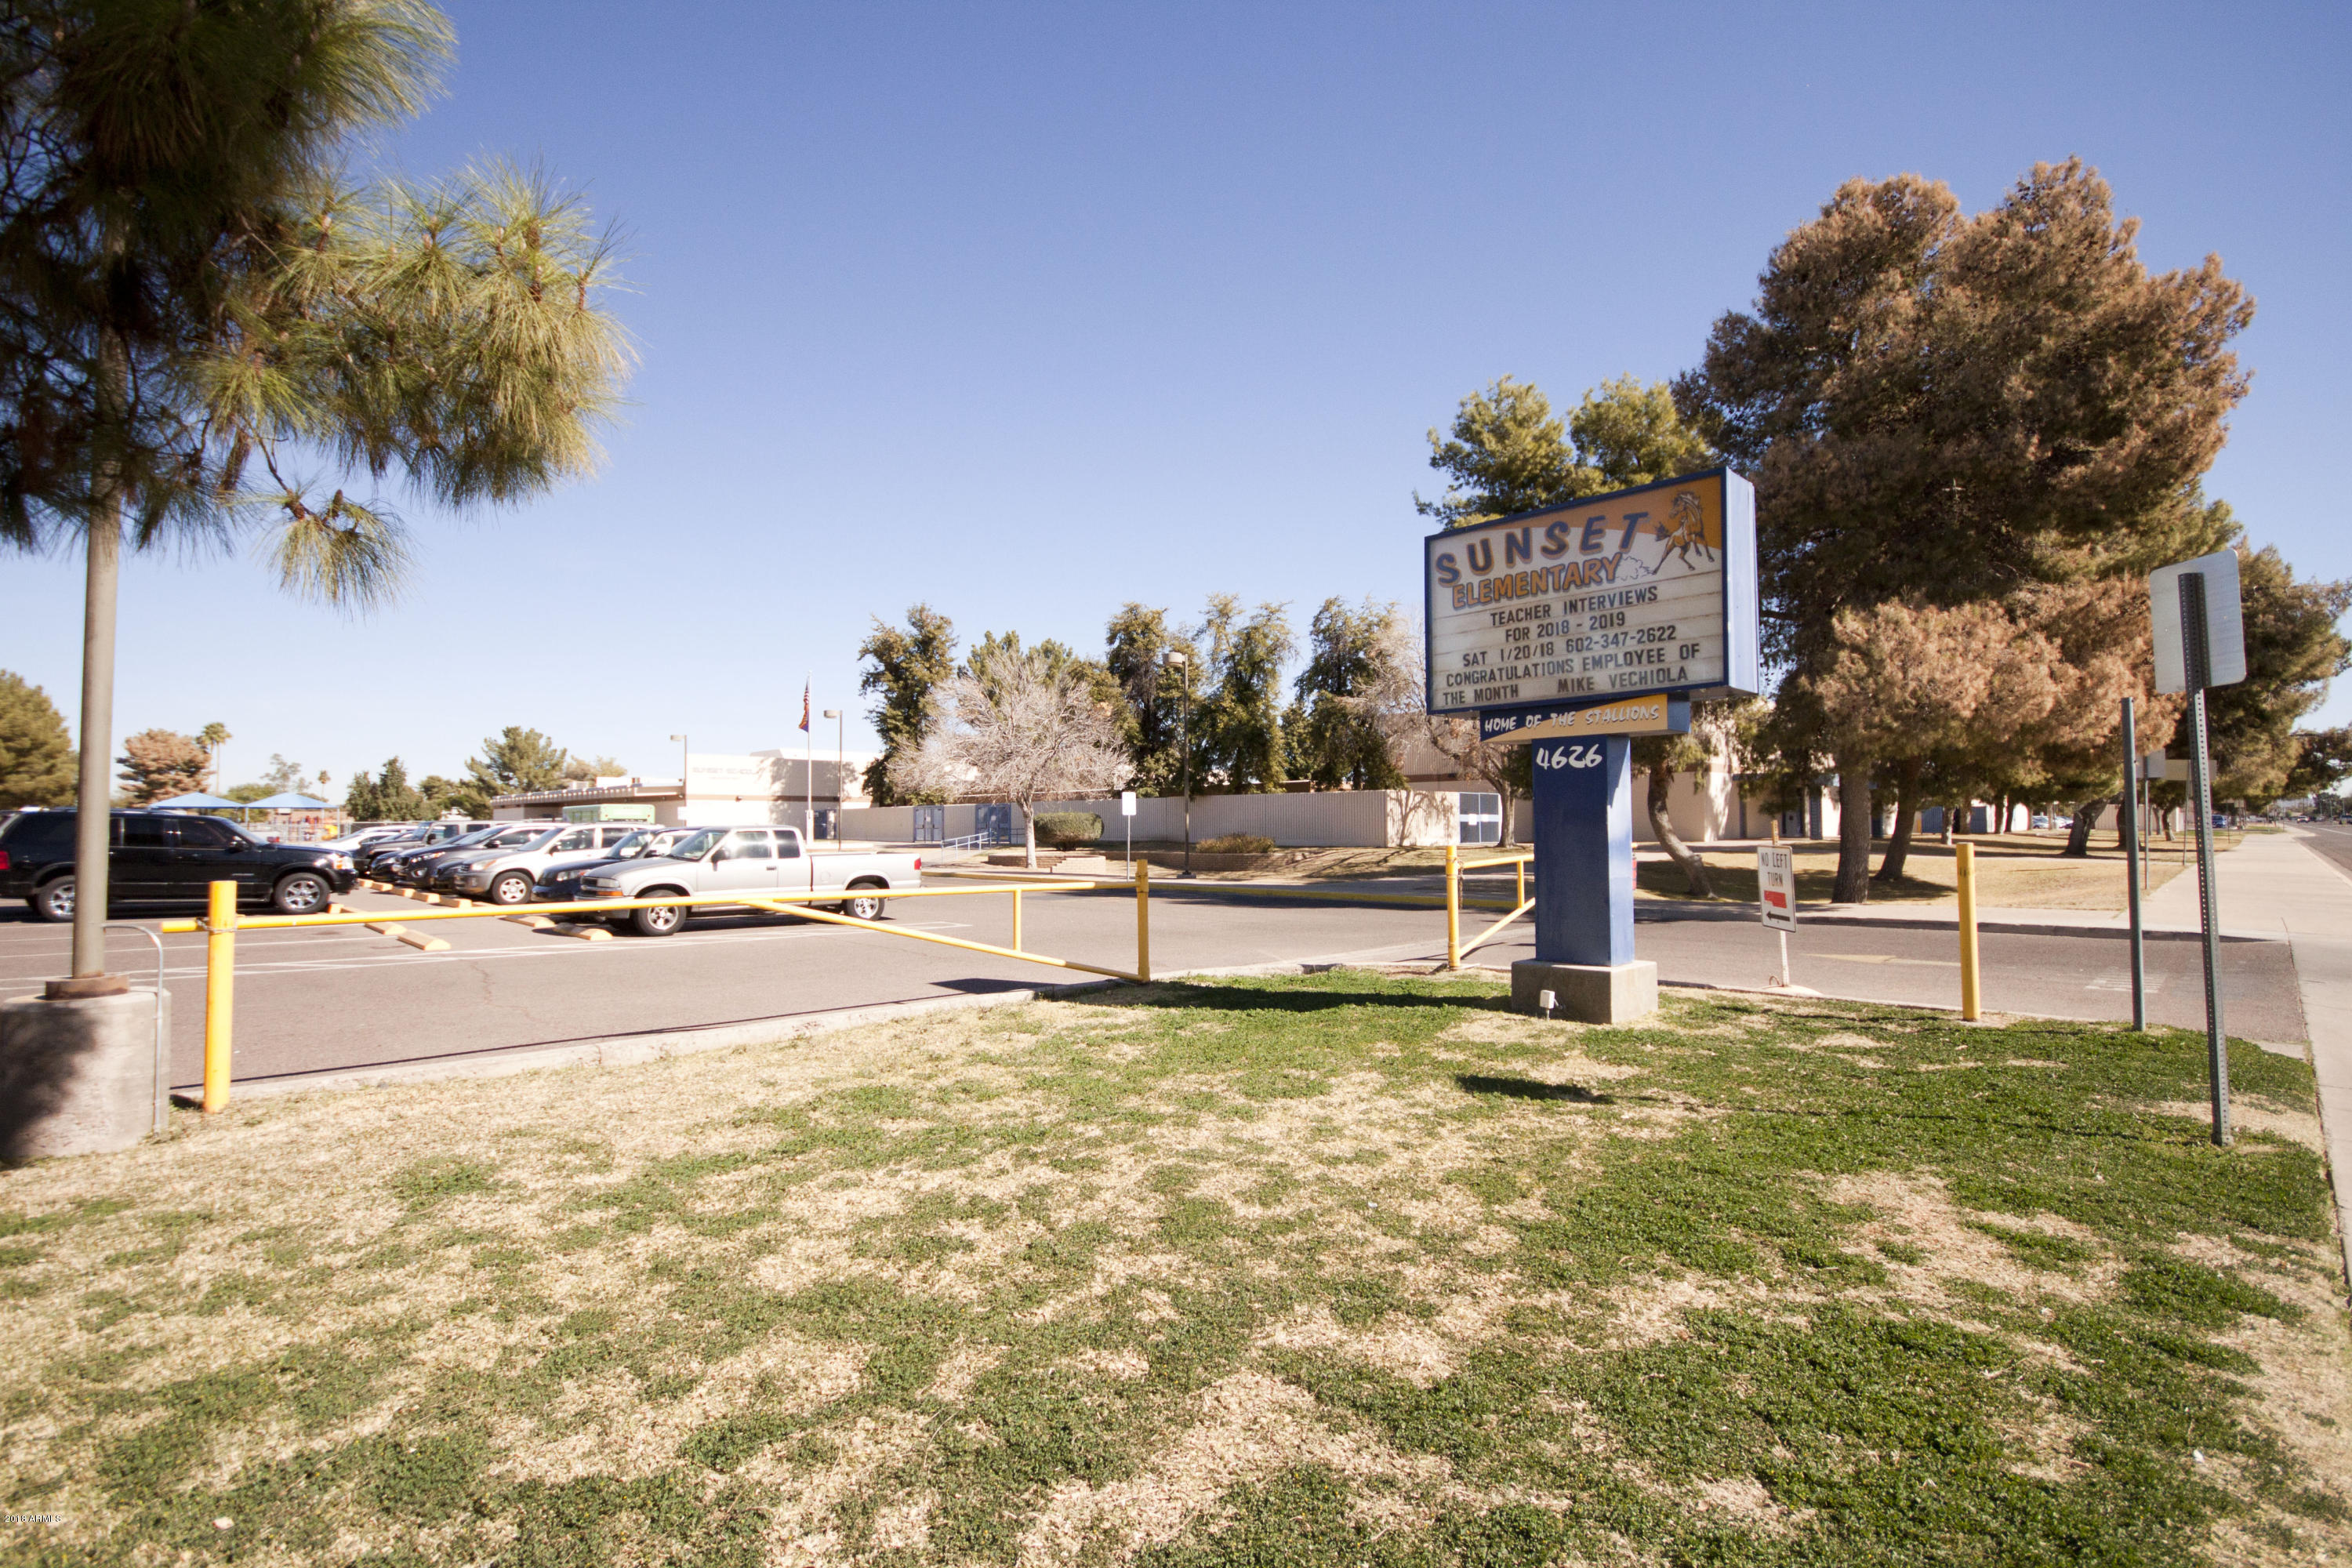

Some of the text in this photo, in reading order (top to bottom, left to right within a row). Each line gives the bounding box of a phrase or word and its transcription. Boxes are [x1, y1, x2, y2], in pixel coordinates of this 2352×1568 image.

[1436, 512, 1650, 586] SUNSET
[1452, 551, 1623, 610] ELEMENTARY
[1490, 586, 1658, 626] TEACHER INTERVIEWS
[1462, 625, 1676, 667] SAT 1/20/18 602-347-2622
[1505, 627, 1530, 642] FOR
[1537, 619, 1570, 638] 2018
[1589, 612, 1625, 630] 2019
[1446, 643, 1700, 687] CONGRATULATIONS EMPLOYEE OF
[1443, 666, 1689, 706] THE MONTH MIKE VECHIOLA
[1484, 704, 1660, 732] HOME OF THE STALLIONS
[1535, 744, 1603, 770] 4626
[1761, 852, 1787, 869] NO LEFT
[1767, 872, 1783, 887] TURN
